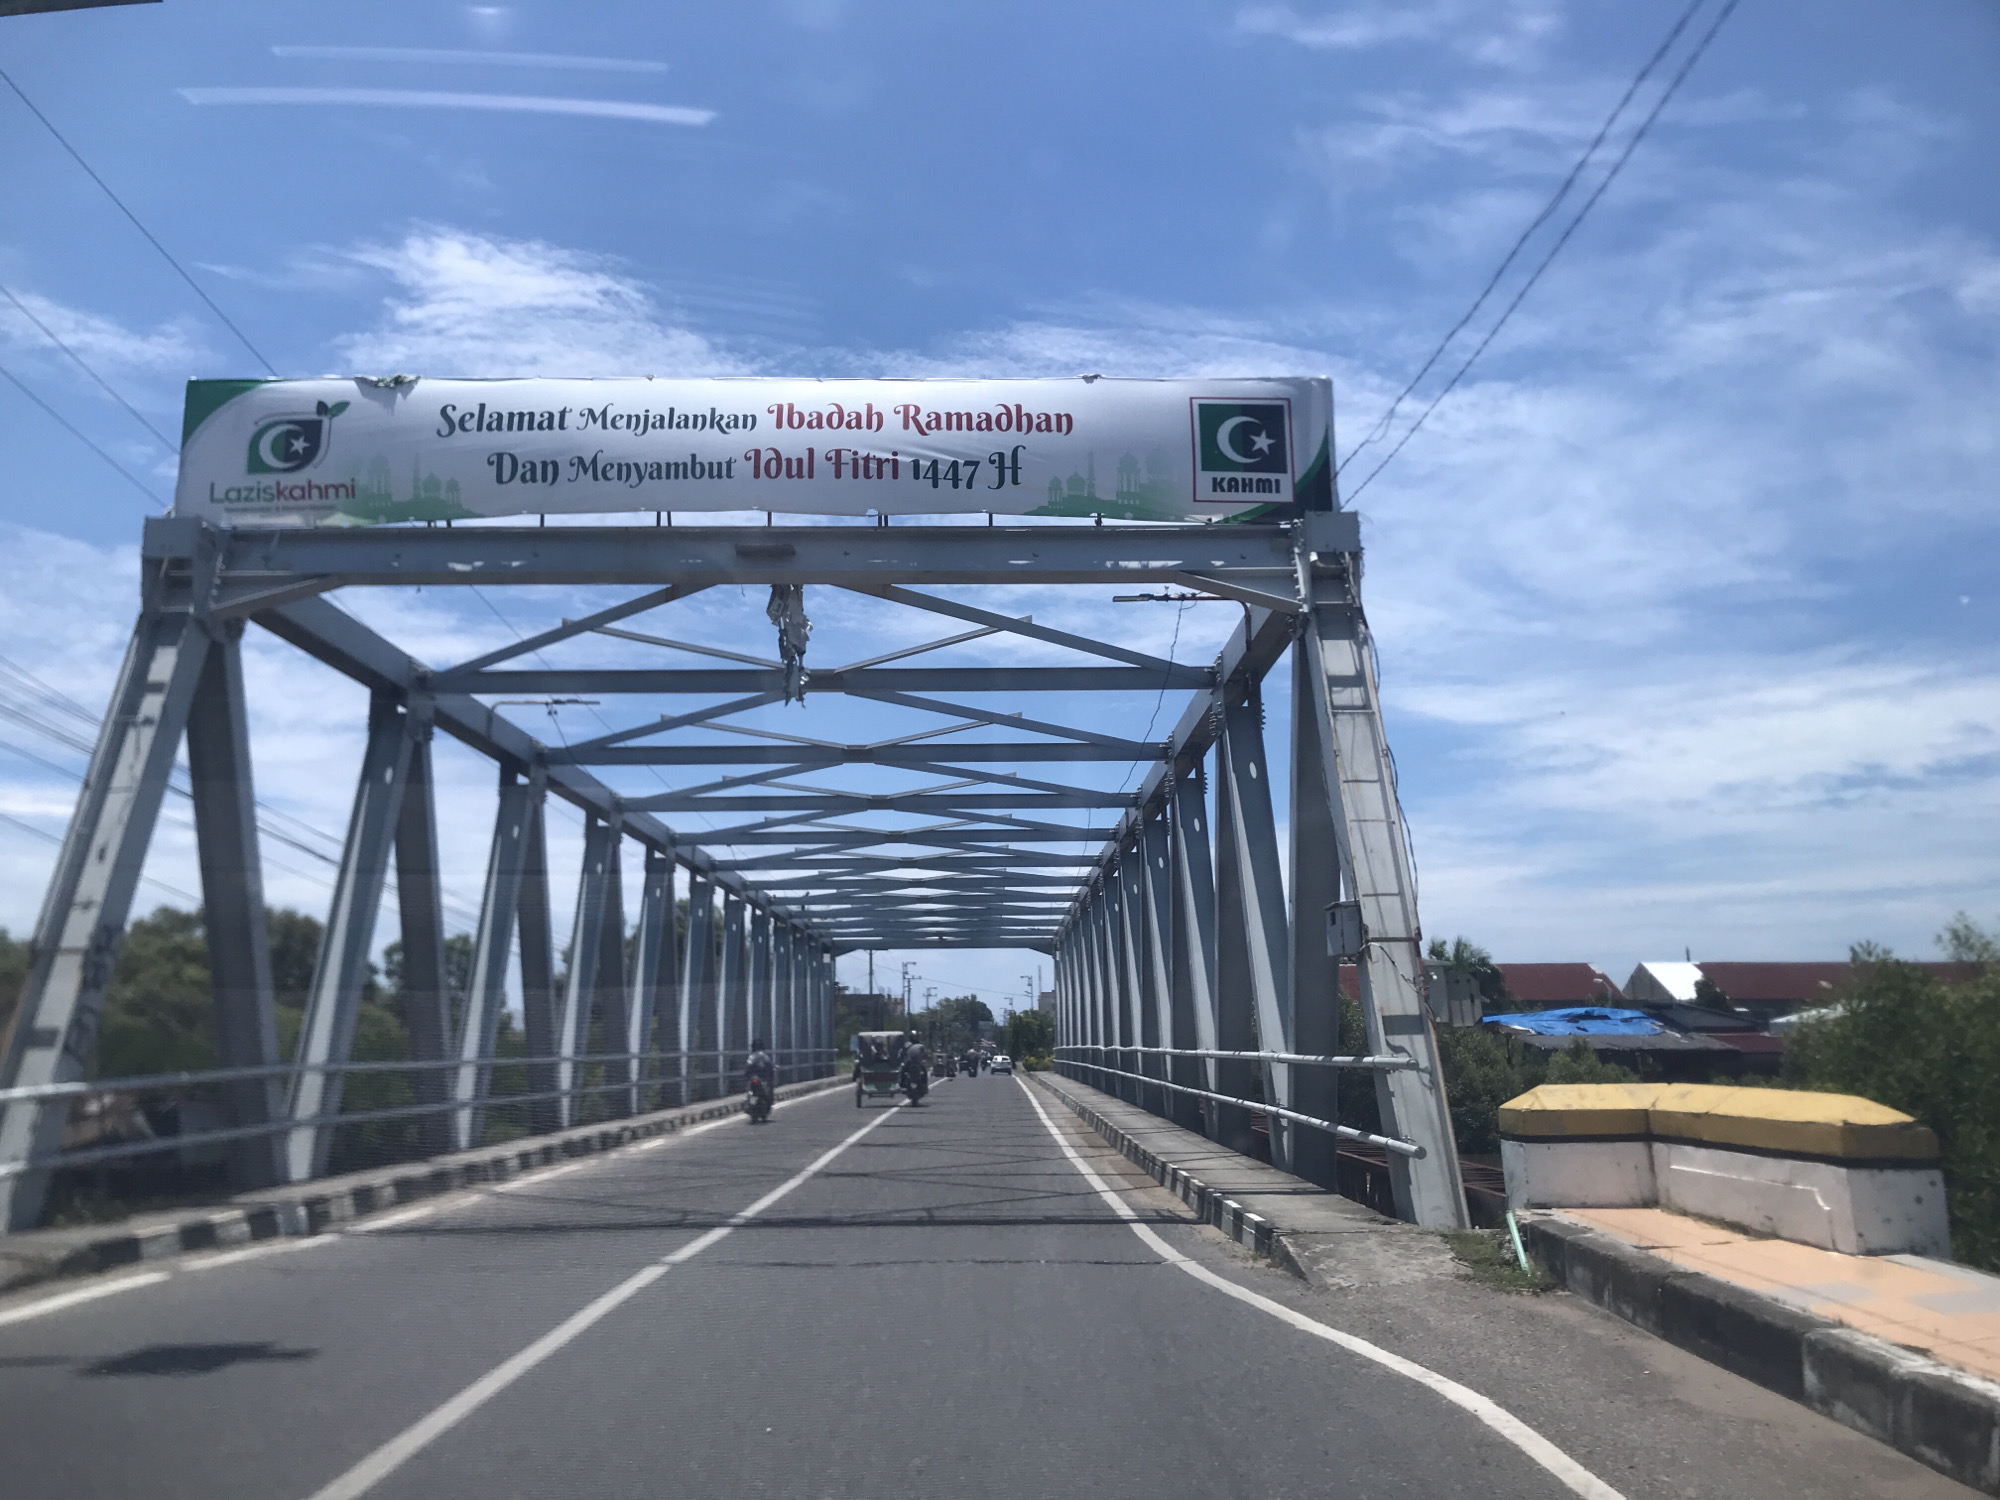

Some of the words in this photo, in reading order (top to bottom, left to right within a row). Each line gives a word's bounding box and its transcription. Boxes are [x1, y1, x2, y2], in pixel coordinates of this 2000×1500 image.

[436, 402, 572, 438] Selamat
[576, 402, 758, 436] Menjalankan
[767, 402, 884, 433] Ibadah
[893, 403, 1074, 436] Ramadhan
[487, 451, 559, 486] Dan
[567, 449, 736, 488] Menyambut
[744, 447, 815, 480] Idul
[825, 447, 899, 480] Fitri
[909, 458, 981, 490] 1447
[987, 445, 1026, 490] H
[209, 477, 356, 503] Laziskahmi
[1212, 476, 1281, 494] KAHMI
